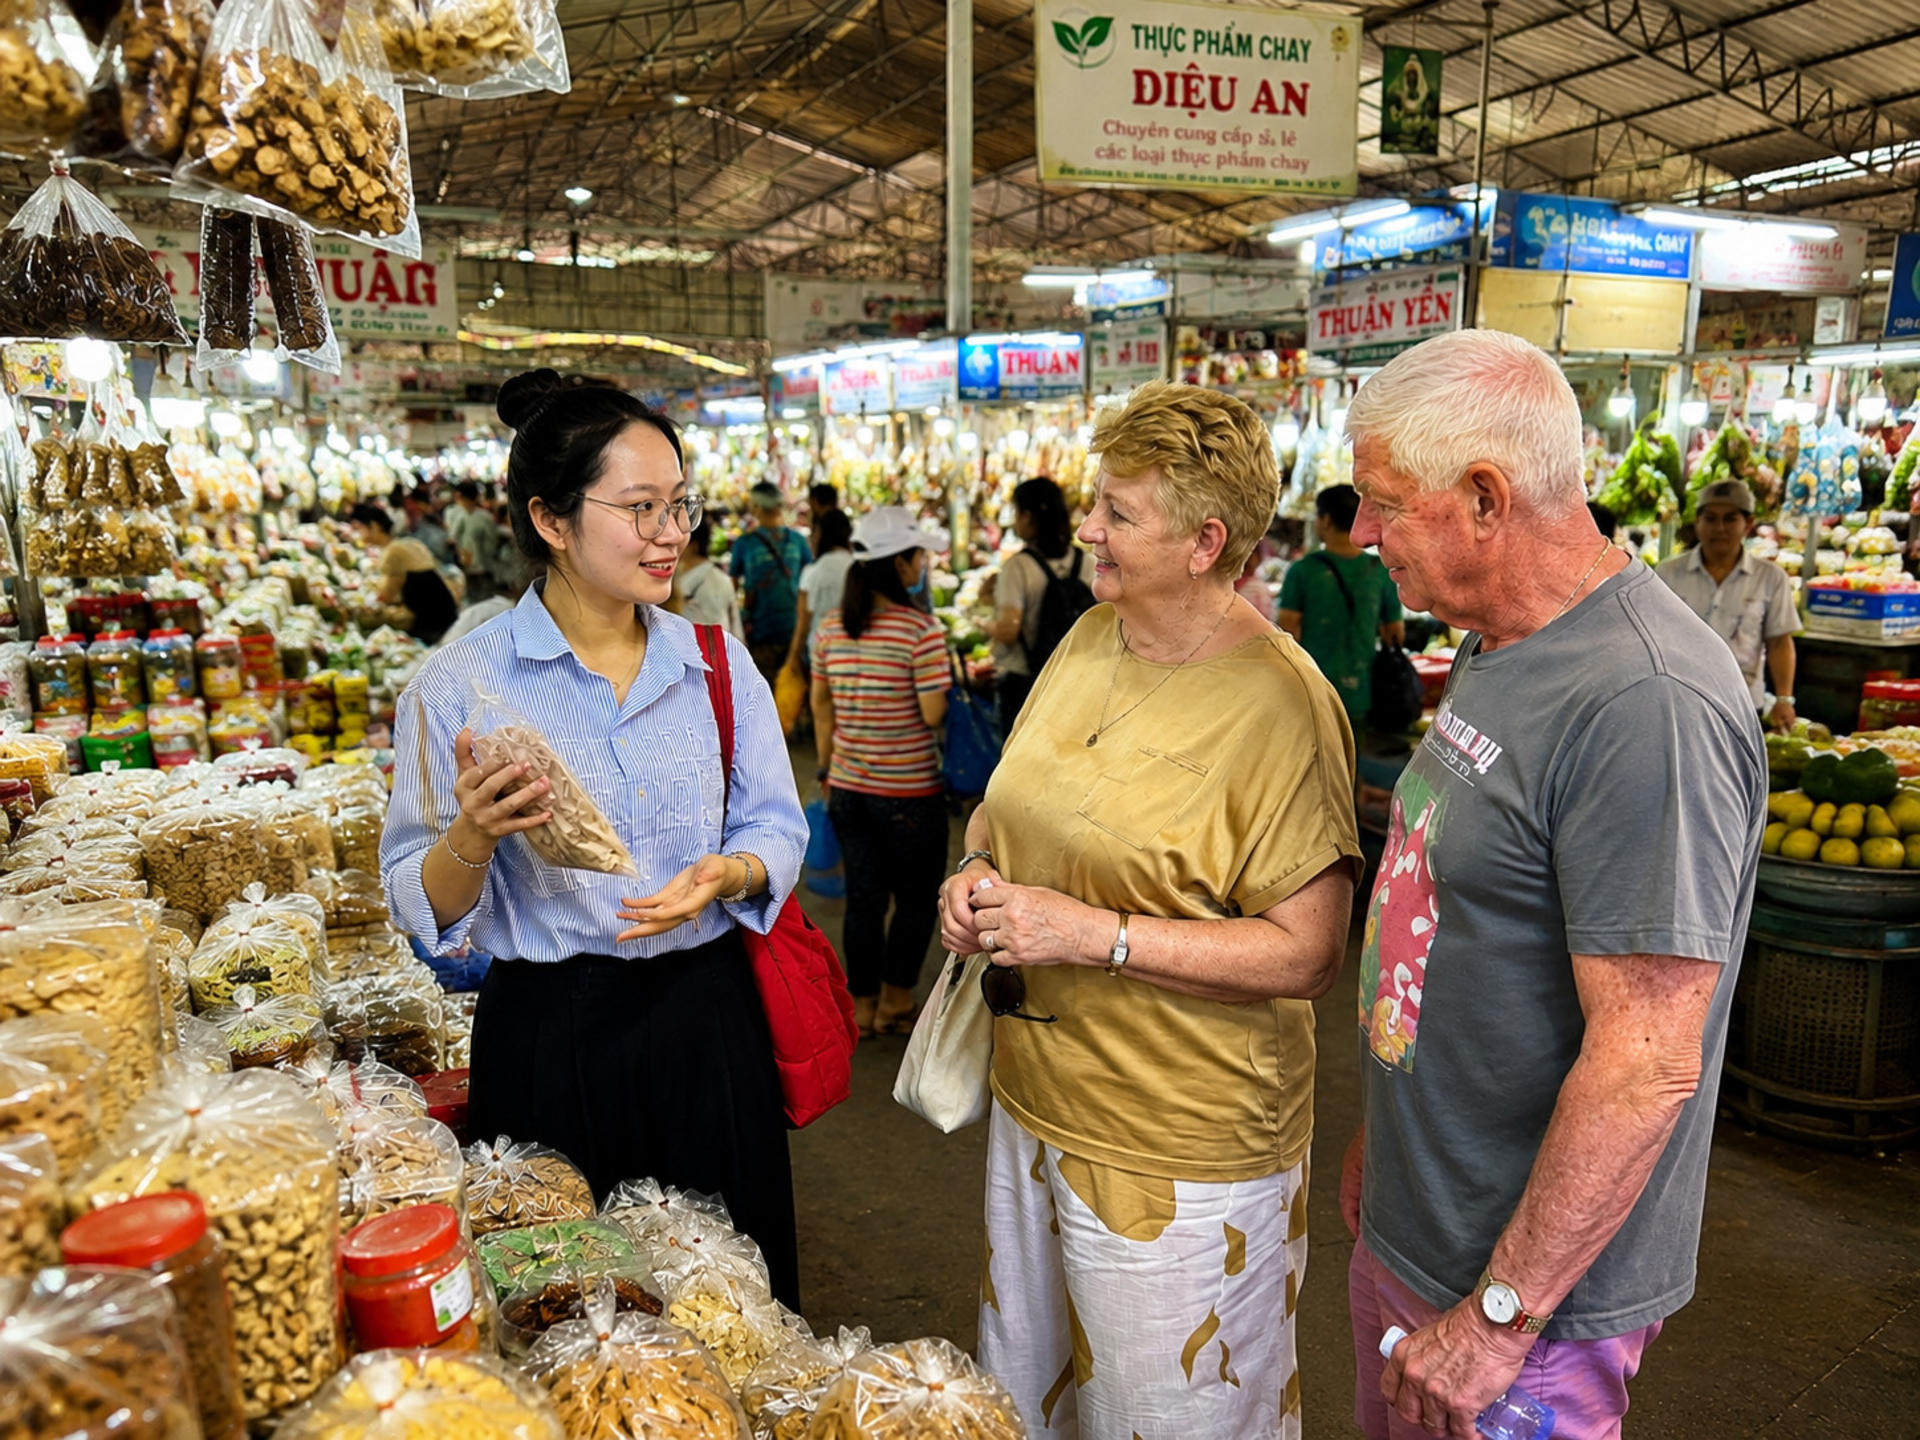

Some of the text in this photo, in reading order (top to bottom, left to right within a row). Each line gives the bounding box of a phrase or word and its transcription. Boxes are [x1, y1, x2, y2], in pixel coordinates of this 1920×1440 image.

[1131, 20, 1312, 63] THỰC PHẨM CHAY
[1250, 78, 1311, 117] AN
[1102, 118, 1170, 141] Chuyên
[1174, 126, 1217, 146] cung
[1095, 143, 1127, 160] các
[1132, 144, 1166, 165] loại
[1270, 153, 1310, 175] chay
[1403, 283, 1453, 327] YÊN
